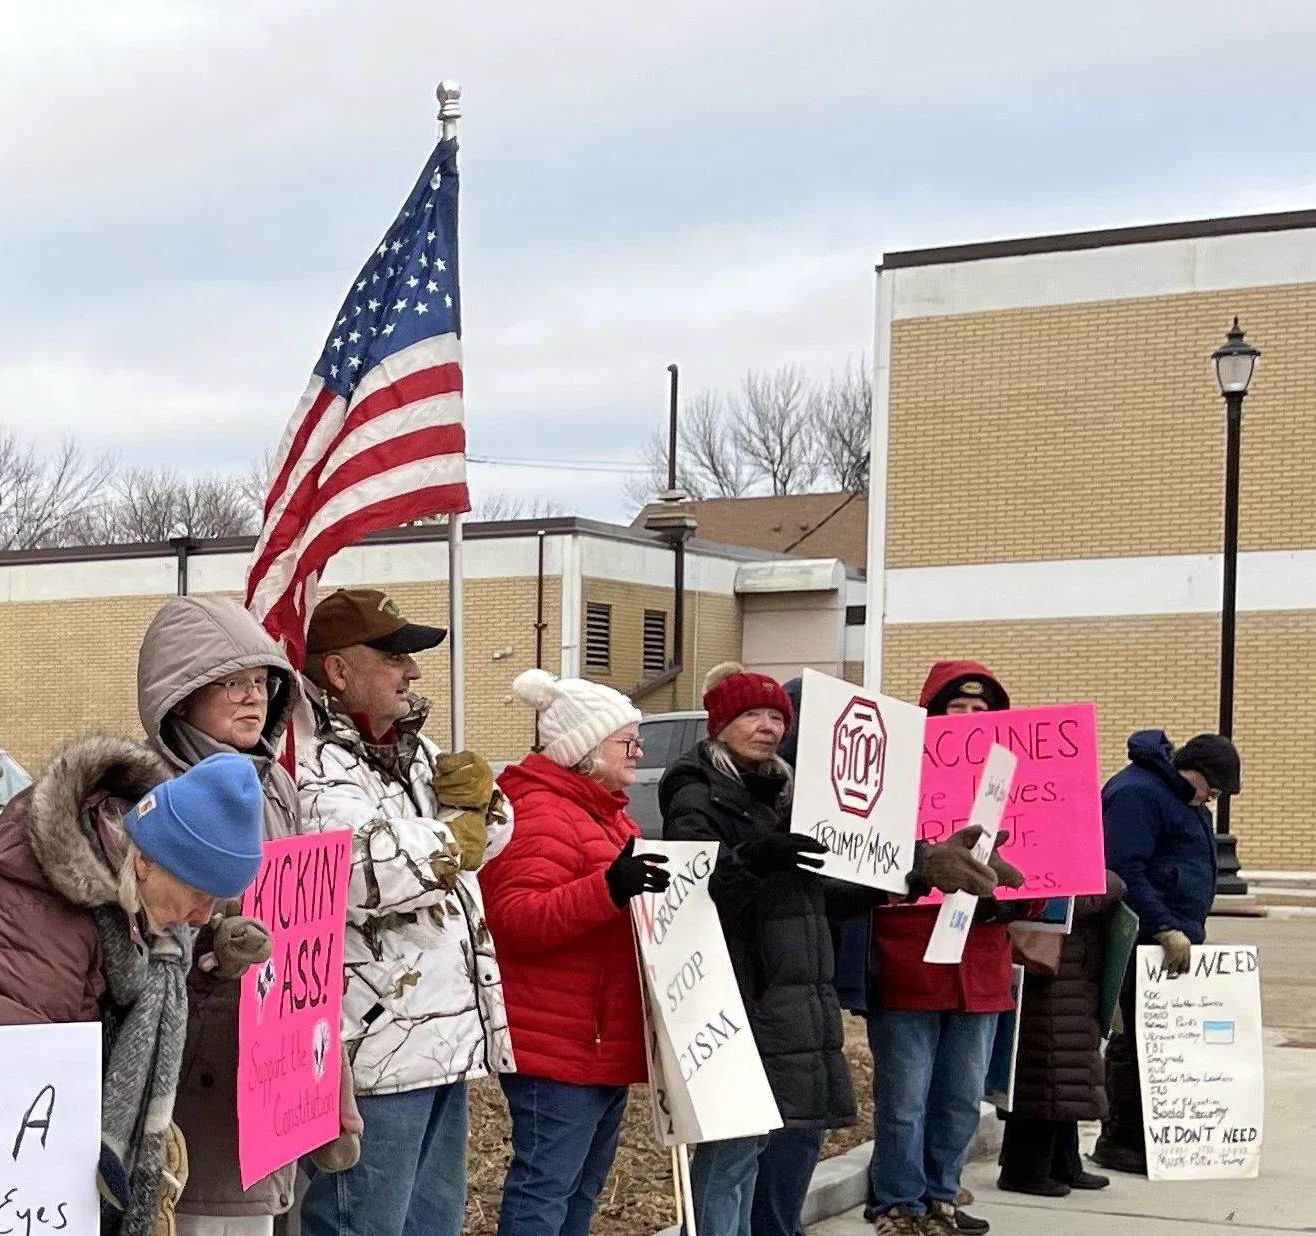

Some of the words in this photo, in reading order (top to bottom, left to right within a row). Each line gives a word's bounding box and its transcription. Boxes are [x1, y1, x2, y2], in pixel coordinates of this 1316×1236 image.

[836, 724, 884, 787] STOP!
[279, 933, 334, 1019] ASS!
[667, 950, 706, 1014] STOP
[1195, 951, 1257, 977] NEED
[291, 1030, 307, 1072] the
[1149, 1126, 1171, 1143] WE
[1222, 1126, 1257, 1143] NEED
